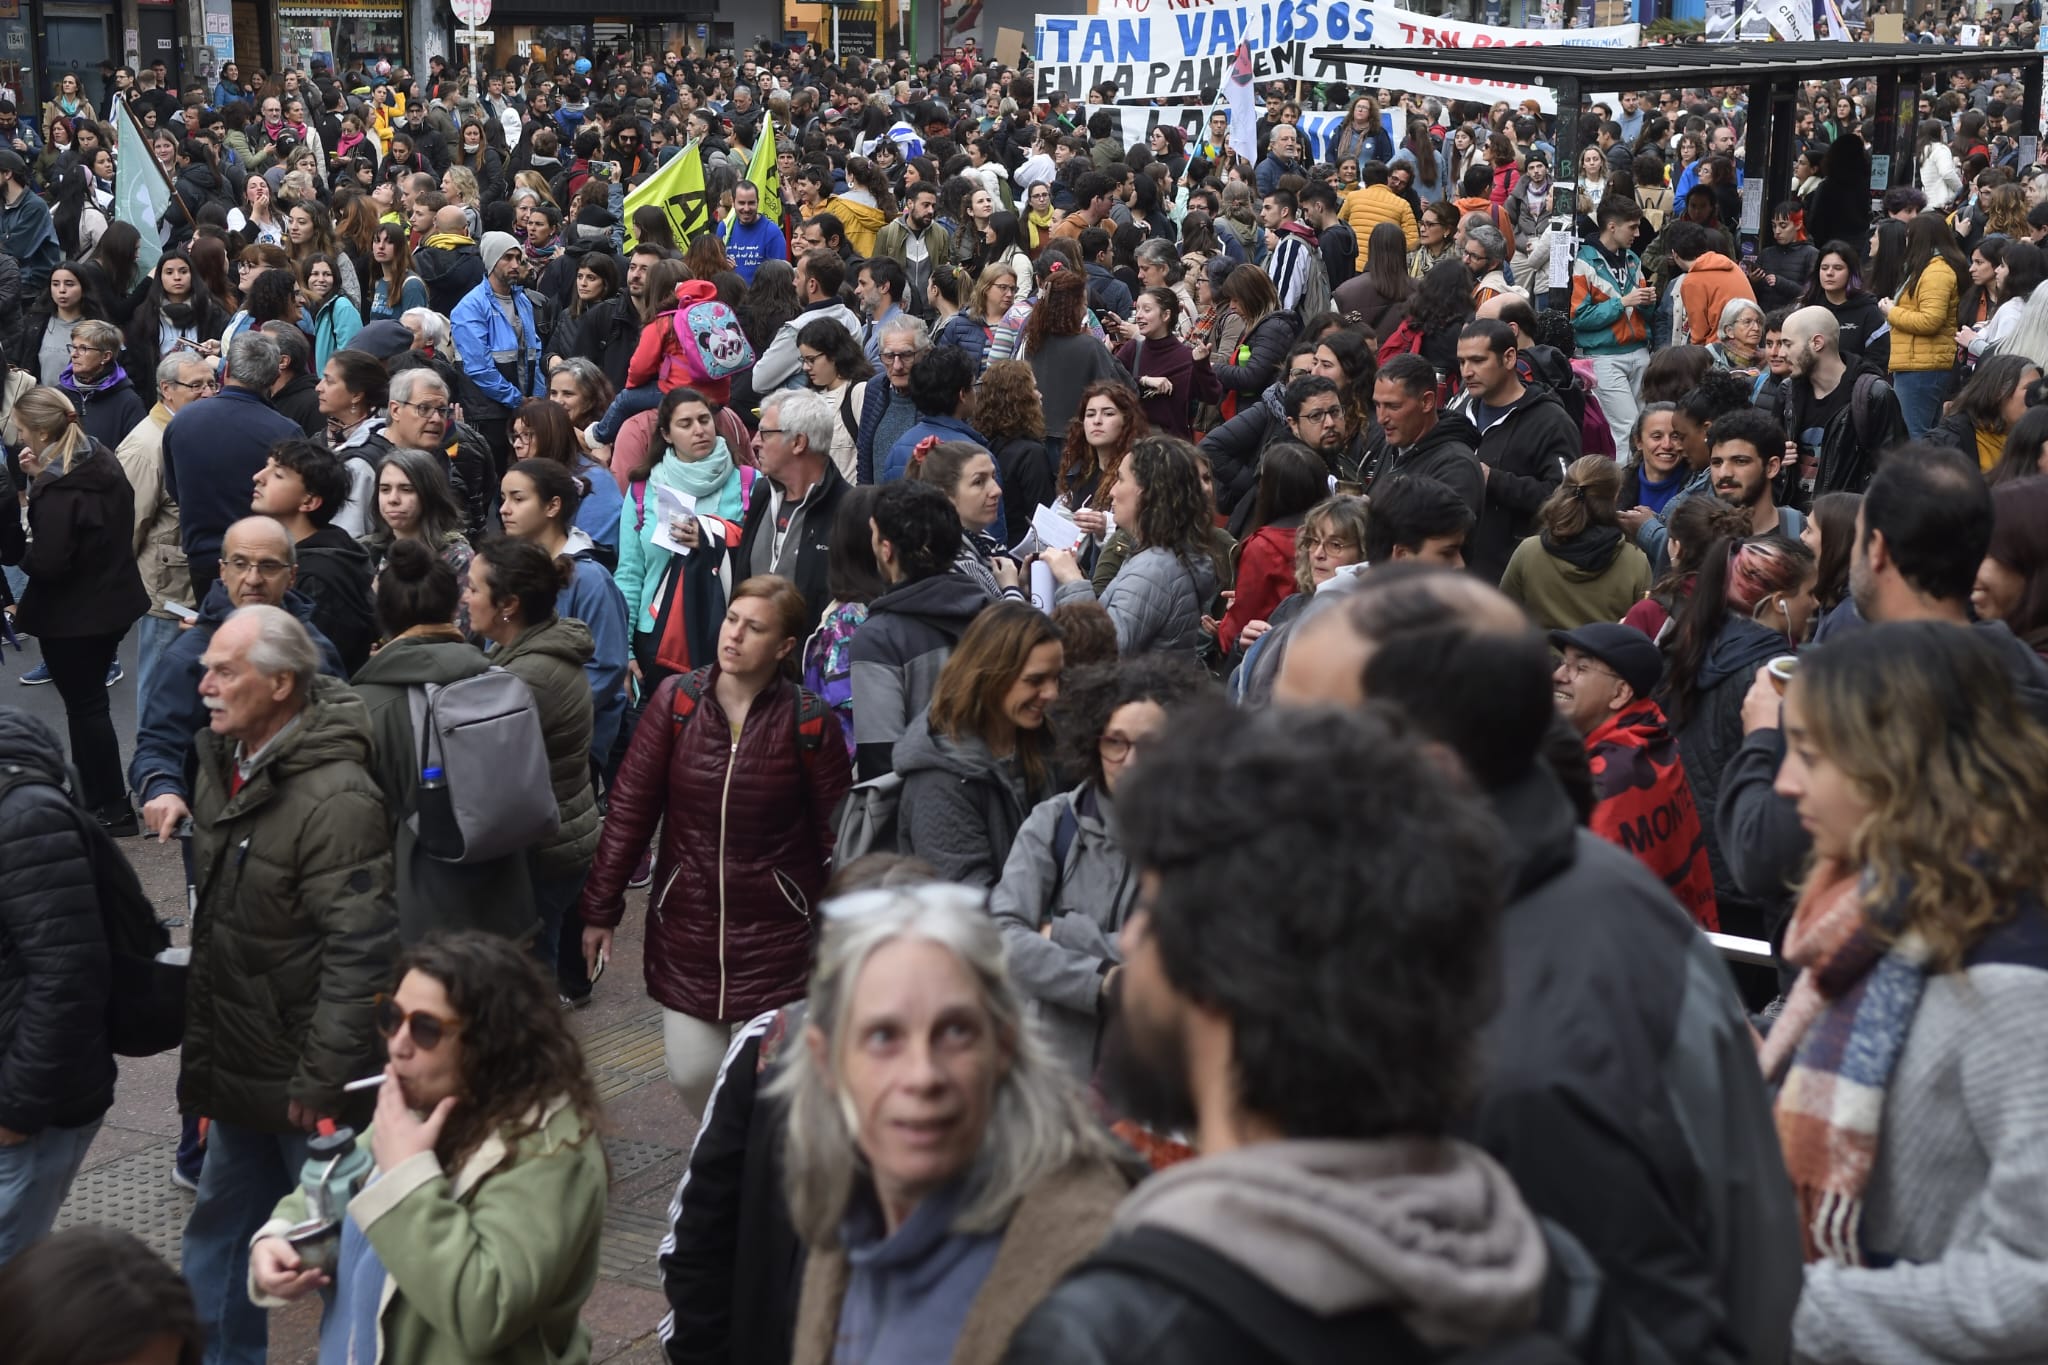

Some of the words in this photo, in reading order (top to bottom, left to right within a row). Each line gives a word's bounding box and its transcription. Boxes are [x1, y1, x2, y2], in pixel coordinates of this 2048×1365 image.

[8, 33, 24, 45] 1841
[1176, 0, 1375, 57] VALIOSOS
[1037, 65, 1082, 100] EN
[1146, 40, 1349, 95] PANEMIA
